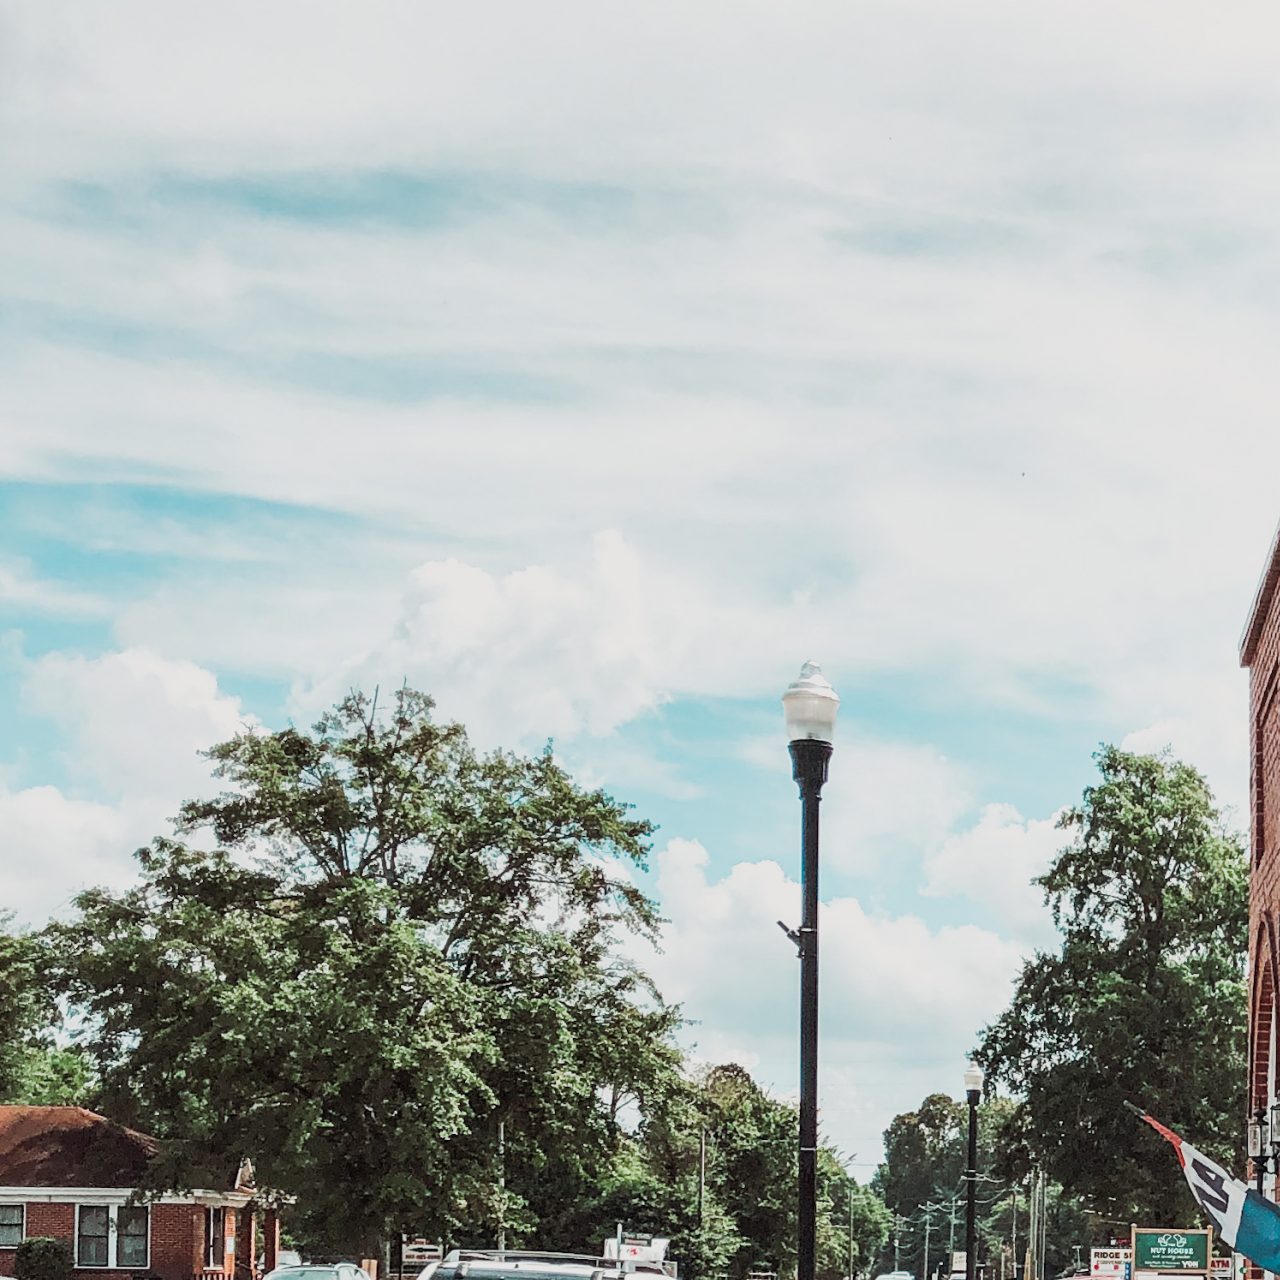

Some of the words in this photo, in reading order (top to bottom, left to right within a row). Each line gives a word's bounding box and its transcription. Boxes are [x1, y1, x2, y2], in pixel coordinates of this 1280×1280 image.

[1094, 1251, 1121, 1259] RIDGE
[1151, 1247, 1167, 1255] NUT
[1168, 1247, 1194, 1255] HOUSE
[1211, 1260, 1230, 1268] ATM
